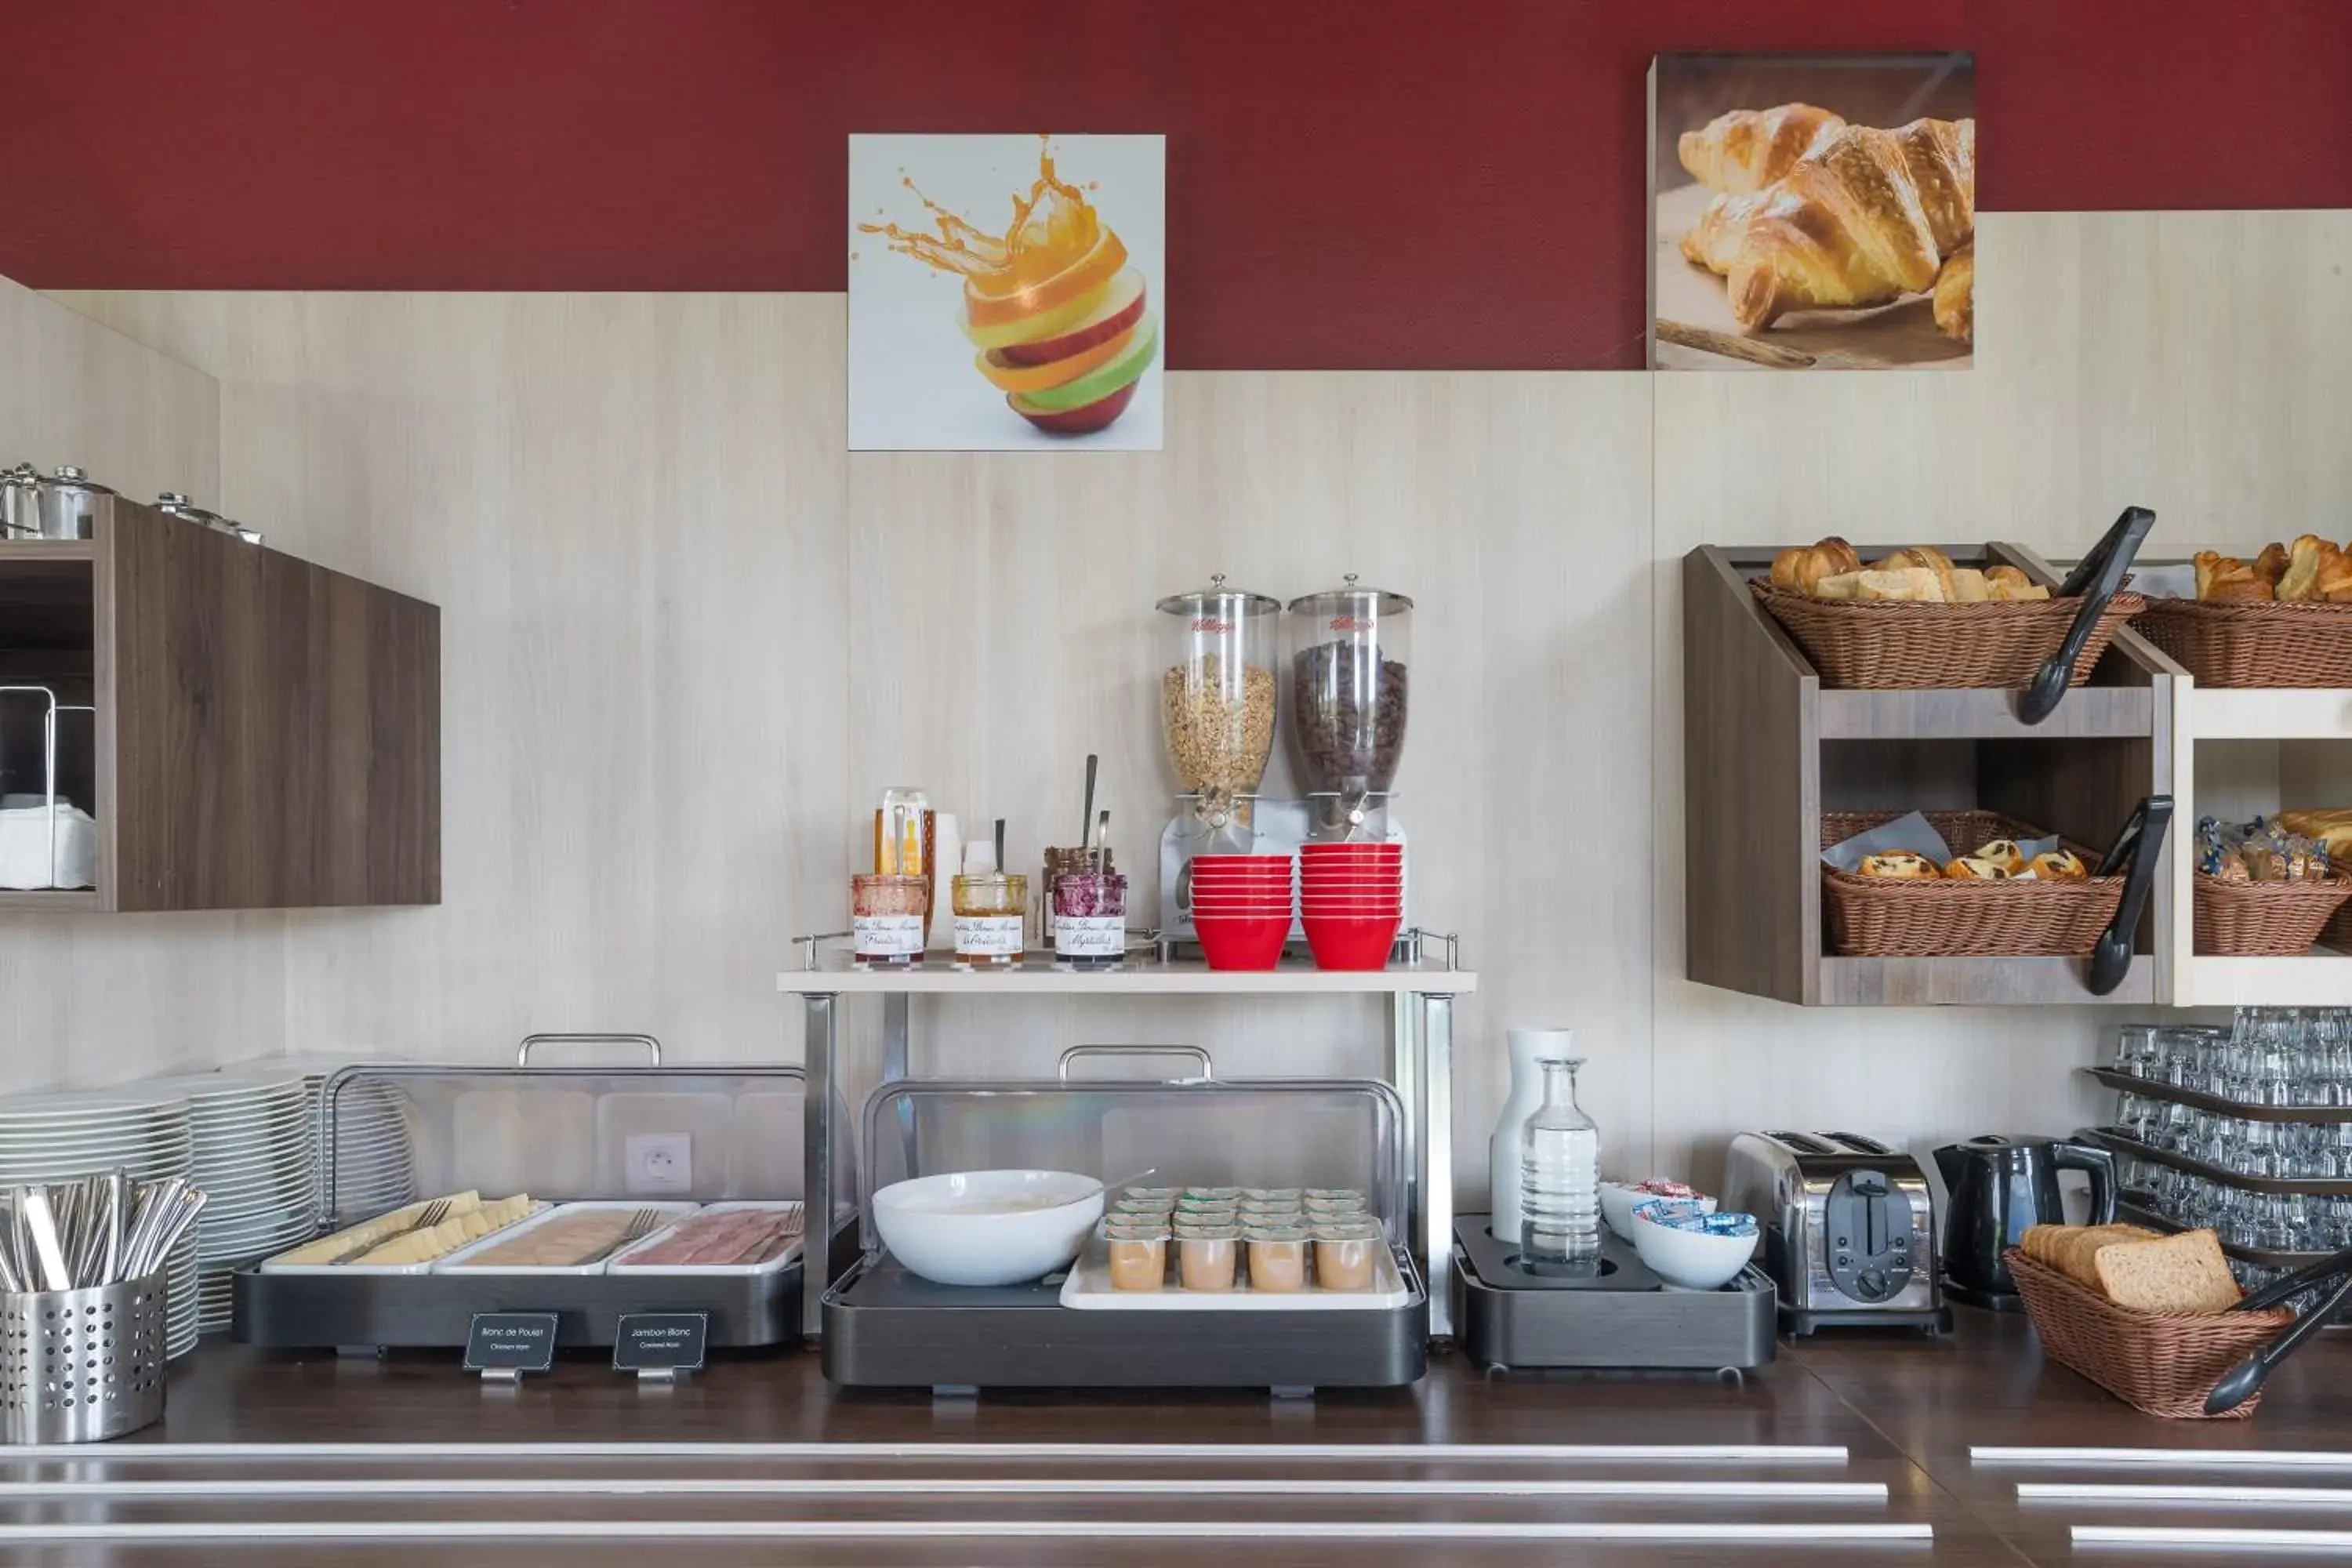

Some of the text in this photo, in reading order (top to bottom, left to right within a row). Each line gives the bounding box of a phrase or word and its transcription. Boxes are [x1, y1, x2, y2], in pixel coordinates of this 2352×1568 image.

[481, 1327, 543, 1337] Blanc de Poulet
[631, 1327, 691, 1337] Jambon Blanc
